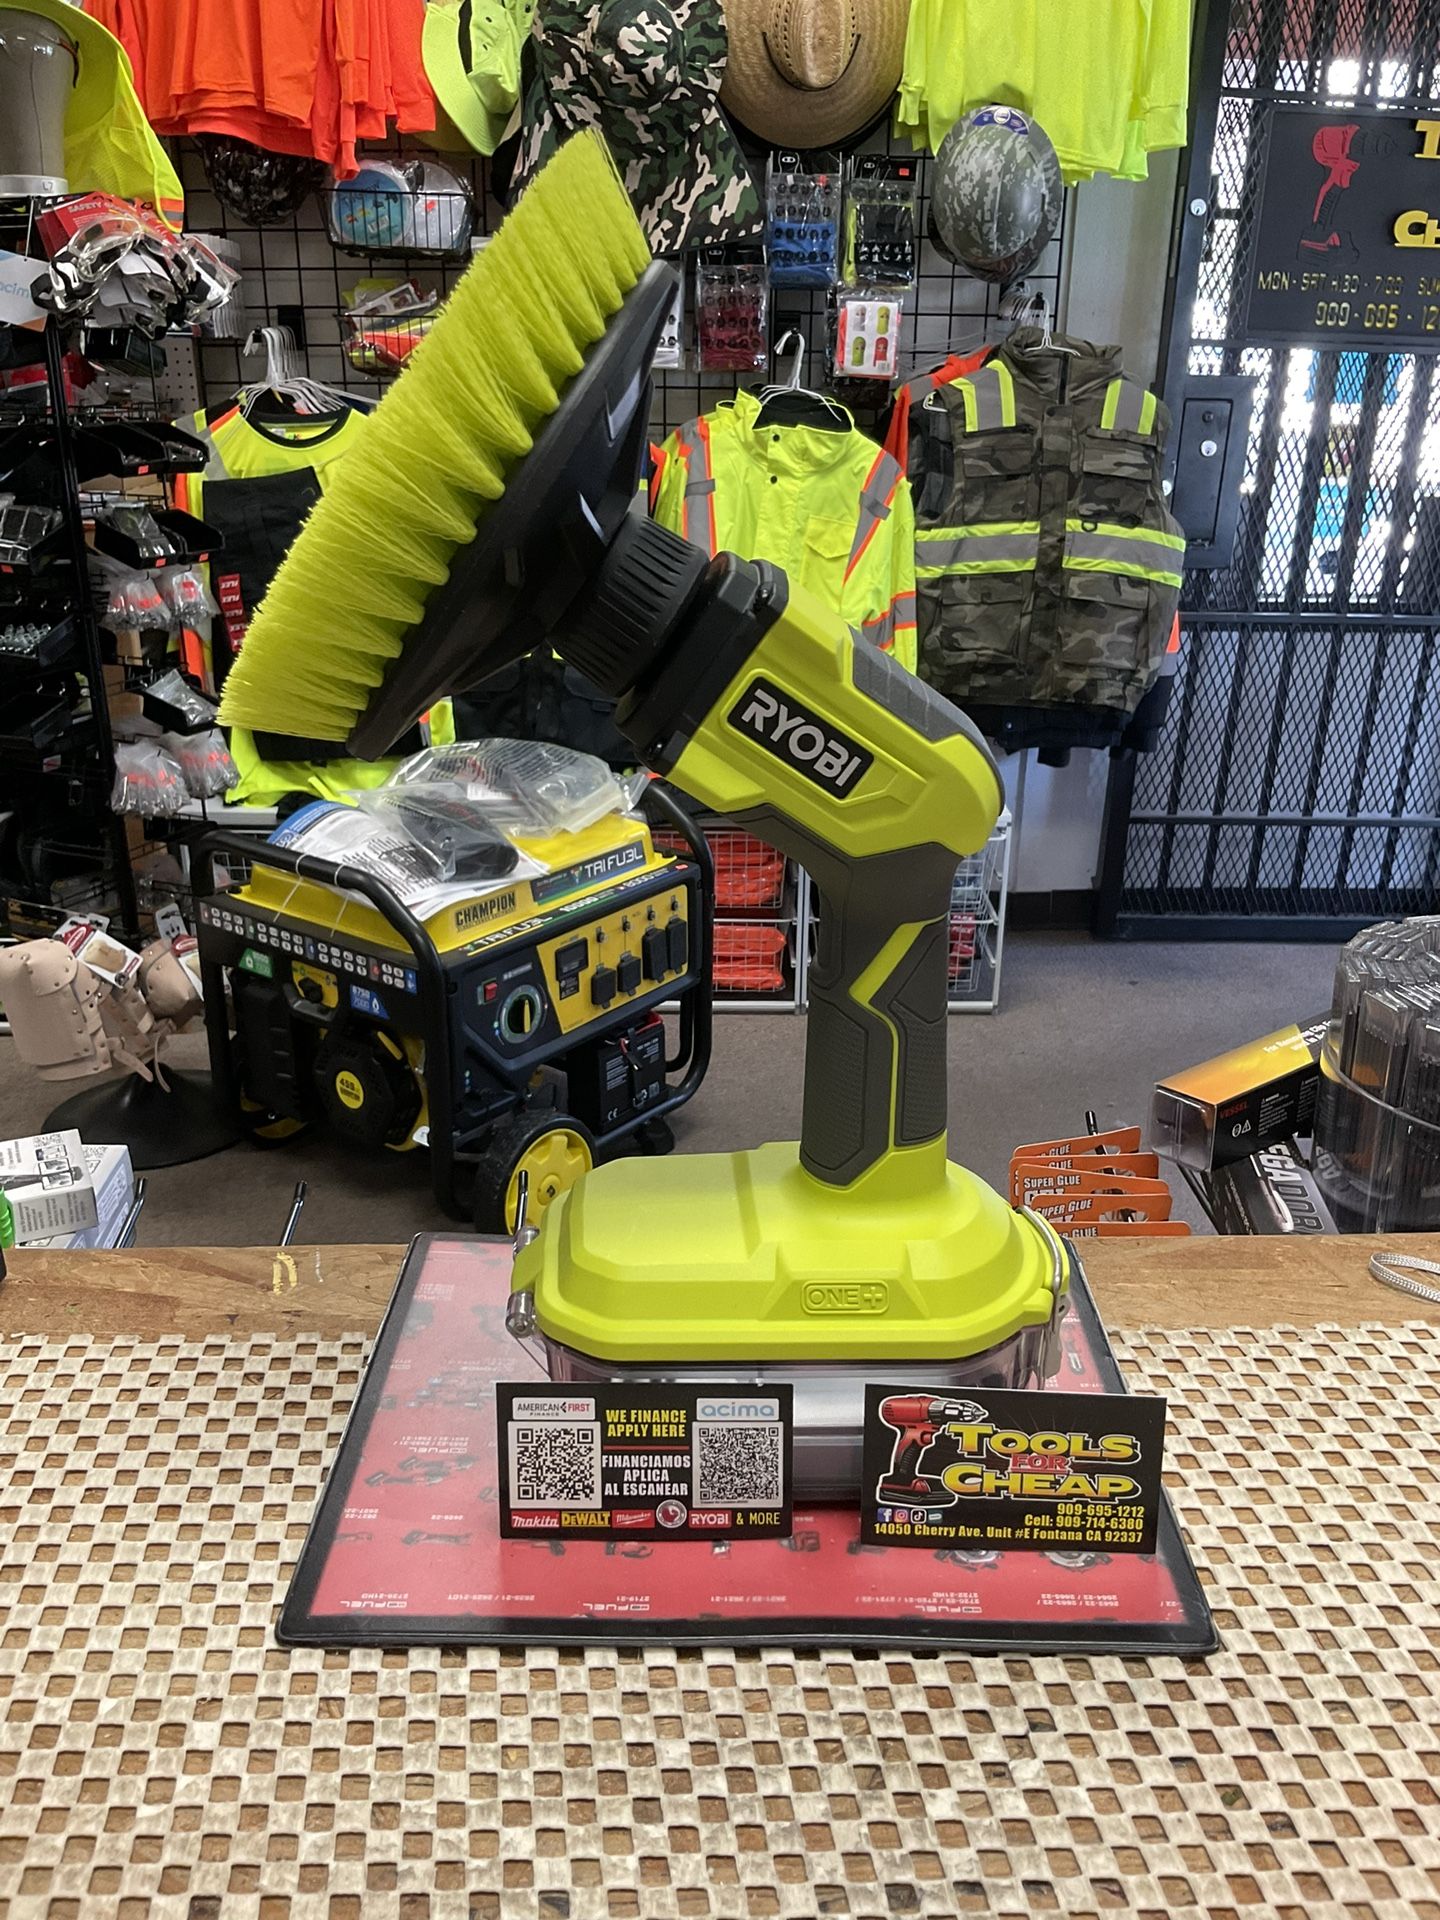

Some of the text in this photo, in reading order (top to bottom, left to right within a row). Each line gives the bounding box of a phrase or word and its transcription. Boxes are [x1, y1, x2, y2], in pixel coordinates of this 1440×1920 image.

[1258, 271, 1290, 290] MON
[741, 688, 862, 787] RYOBI
[456, 892, 516, 926] CHAMPION
[1024, 1174, 1081, 1189] SUPER GLUE
[1068, 1198, 1092, 1211] GLUE
[1072, 1226, 1098, 1238] GLUE
[517, 1402, 590, 1412] AMERICAN FIRST
[701, 1401, 774, 1417] acima
[606, 1409, 687, 1424] WE FINANCE
[608, 1424, 686, 1438] APPLY HERE
[947, 1422, 1138, 1461] TOOLS
[602, 1454, 691, 1468] FINANCIAMOS
[1009, 1453, 1071, 1473] FOR
[624, 1469, 670, 1482] APLICA
[942, 1462, 1141, 1500] CHEAP
[604, 1483, 688, 1496] AL ESCANEAR
[1057, 1502, 1144, 1518] 909-695-1212
[691, 1514, 729, 1525] RYOBI
[736, 1512, 744, 1526] &
[750, 1512, 780, 1526] MORE
[1024, 1514, 1144, 1531] Cell: 909-714-6380
[874, 1522, 1143, 1544] 14050 Cherry Ave. Unit #E Fontana CA 92337
